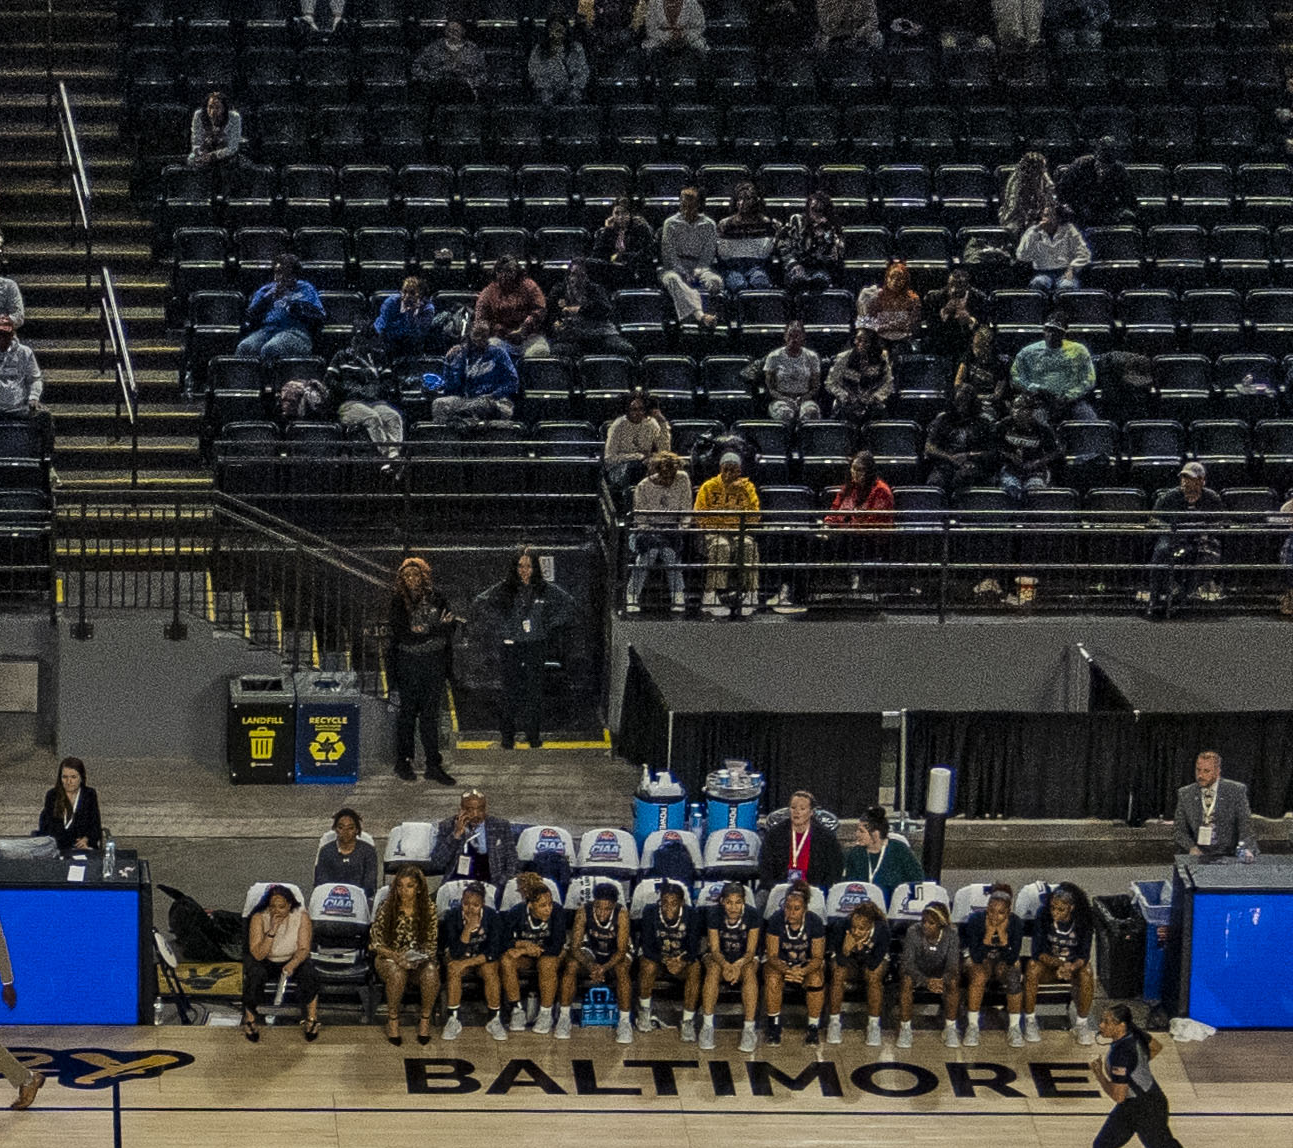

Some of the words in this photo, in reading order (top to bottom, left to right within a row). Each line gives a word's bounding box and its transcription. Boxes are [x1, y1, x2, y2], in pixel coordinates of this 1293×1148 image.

[241, 716, 285, 725] LANDFILL
[308, 716, 348, 725] RECYCLE
[404, 1057, 1106, 1099] BALTIMORE
